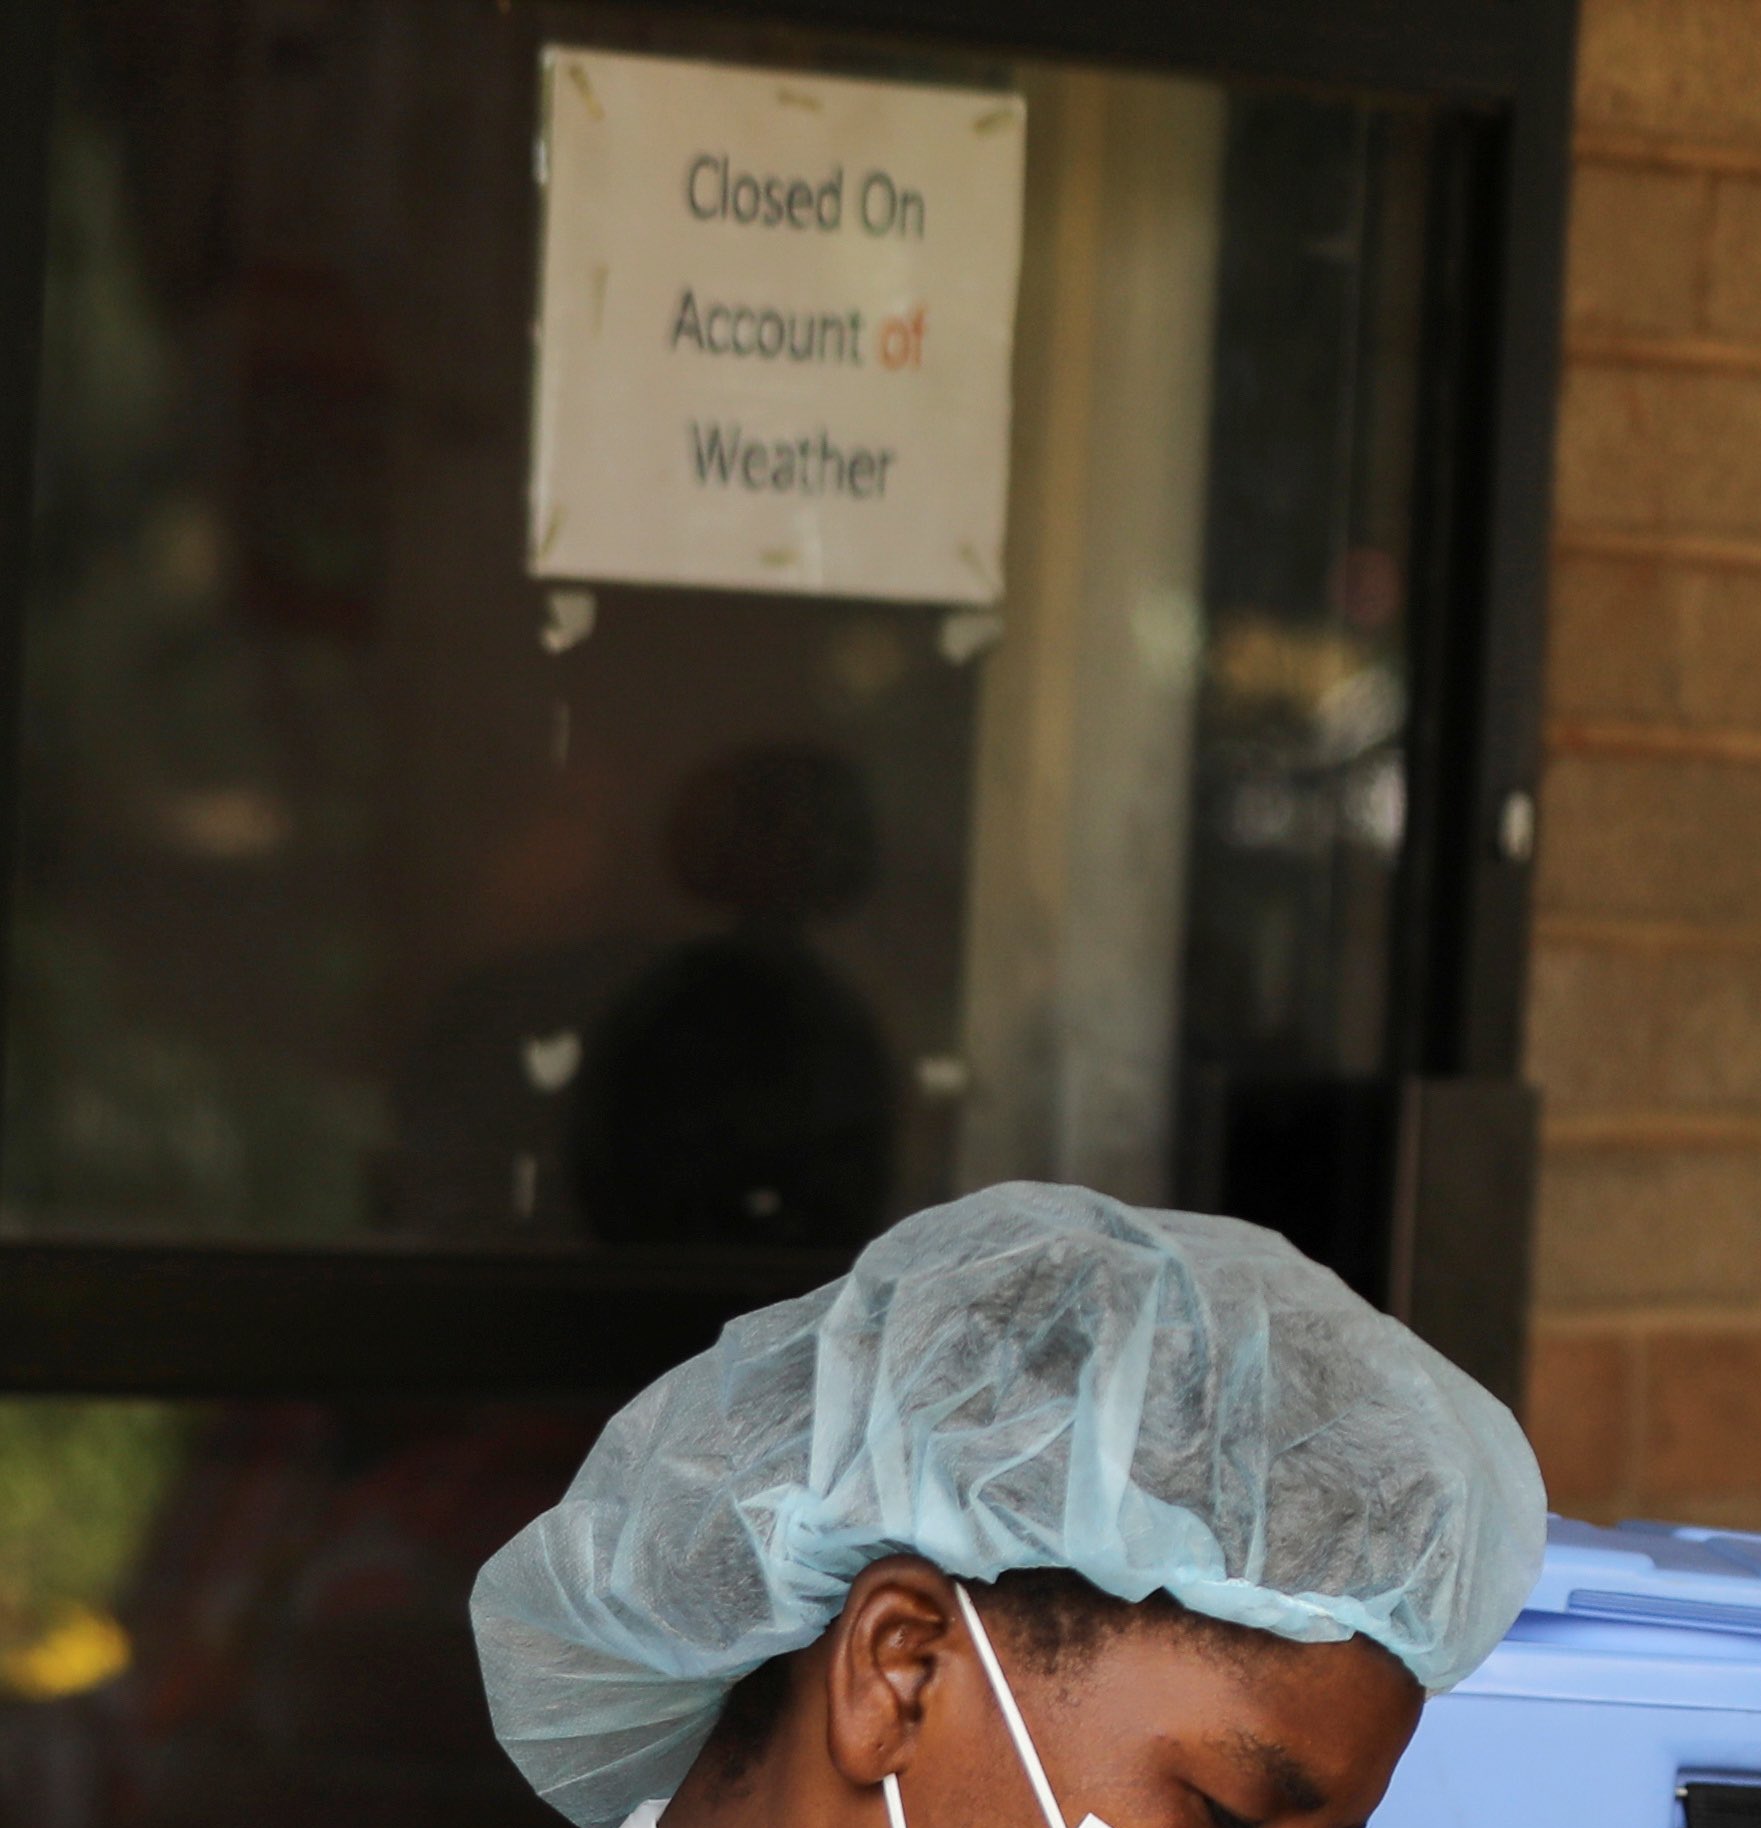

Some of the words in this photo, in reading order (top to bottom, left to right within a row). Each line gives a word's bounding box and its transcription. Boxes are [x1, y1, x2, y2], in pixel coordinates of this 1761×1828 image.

[686, 150, 844, 235] Closed
[860, 171, 925, 239] On
[670, 286, 862, 365] Account
[879, 297, 928, 370] of
[690, 419, 896, 499] Weather
